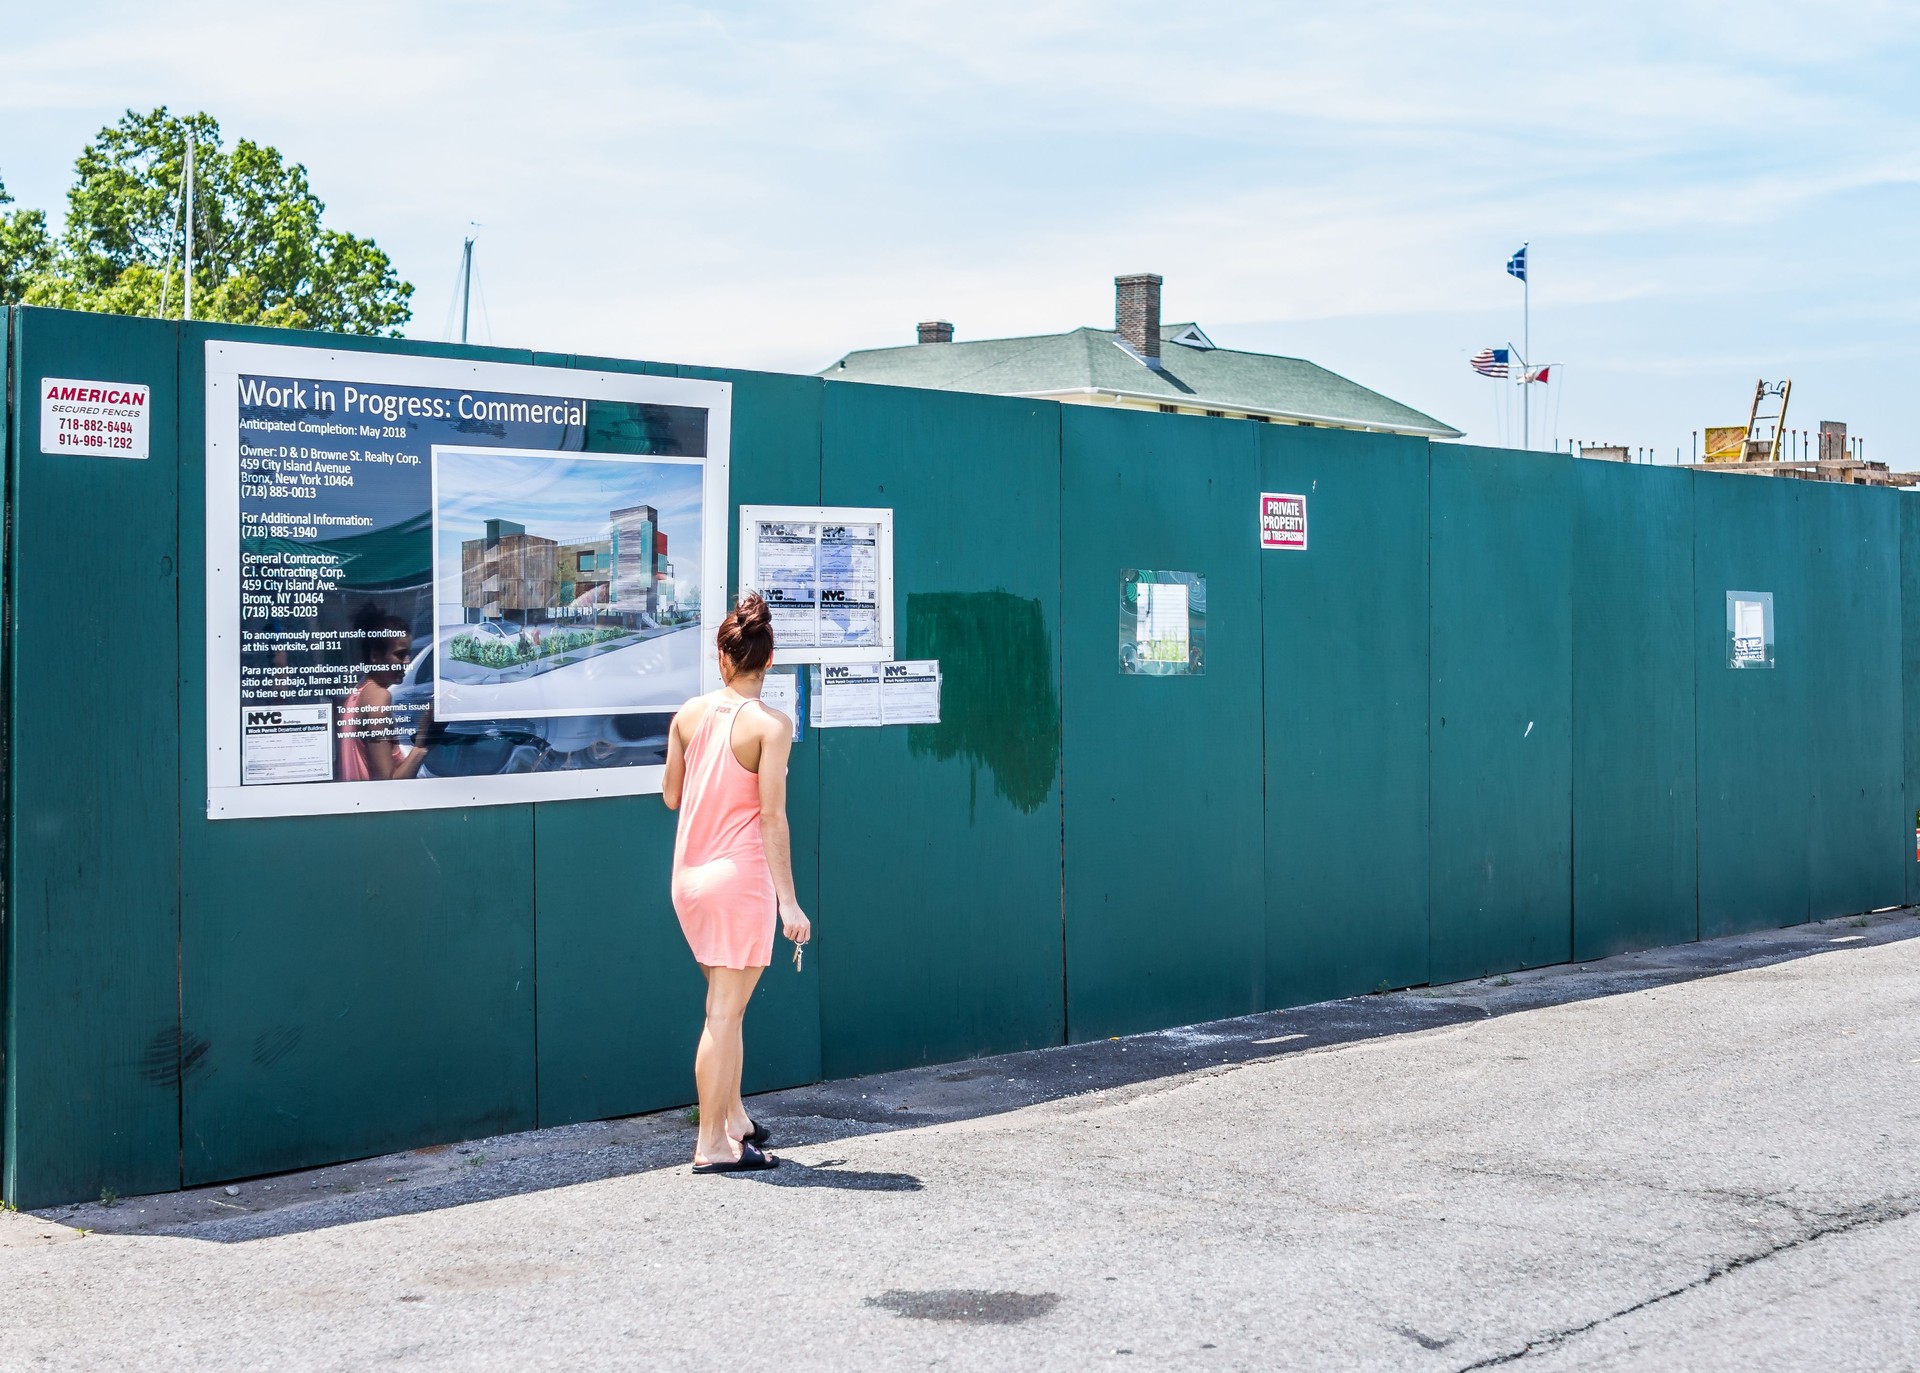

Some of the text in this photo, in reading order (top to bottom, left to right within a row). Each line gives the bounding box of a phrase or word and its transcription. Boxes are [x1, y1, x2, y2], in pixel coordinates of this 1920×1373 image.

[47, 386, 145, 406] AMERICAN
[240, 379, 588, 426] Work in Progress: Commercial
[52, 405, 141, 418] SECURED FENCES
[59, 418, 132, 434] 718-882-6494
[240, 418, 407, 439] Anticipated Completion: May 2018
[59, 433, 132, 449] 914-969-1292
[241, 445, 422, 467] Owner: D & D Browne St. Realty Corp.
[241, 459, 351, 474] 459 City Island Avenue
[242, 472, 354, 487] Bronx, New York 10464
[242, 486, 316, 499] (718) 885-0013
[1268, 501, 1300, 516] PRIVATE
[242, 512, 373, 526] For Additional Information:
[1264, 516, 1303, 530] PROPERTY
[242, 526, 318, 539] (718) 885-1940
[761, 524, 785, 536] NYC
[822, 526, 845, 538] NYC
[242, 552, 339, 565] General Contractor:
[261, 566, 318, 580] Contracting
[320, 567, 346, 580] Corp.
[242, 580, 338, 592] 459 City Island Ave.
[243, 593, 324, 605] Bronx, NY 10464
[822, 590, 845, 601] NYC
[243, 606, 318, 620] (718) 885-0203
[243, 631, 252, 640] To
[254, 630, 310, 641] anonymously
[312, 630, 338, 641] report
[340, 629, 366, 639] unsafe
[243, 641, 342, 652] at this worksite, call 311
[243, 666, 260, 675] Para
[263, 666, 298, 677] reportar
[300, 664, 348, 674] condiciones
[350, 663, 390, 674] peligrosas
[826, 667, 848, 677] NYC
[885, 666, 907, 676] NYC
[242, 675, 358, 688] sitio de trabajo, llame al 311
[242, 686, 360, 700] No tiene que dar su nombre.
[381, 704, 407, 714] permits
[408, 703, 430, 711] issued
[248, 712, 282, 725] NYC
[348, 717, 362, 726] this
[363, 716, 394, 727] property,
[396, 716, 411, 724] visit:
[337, 728, 416, 739] www.nyc.gov/buildings
